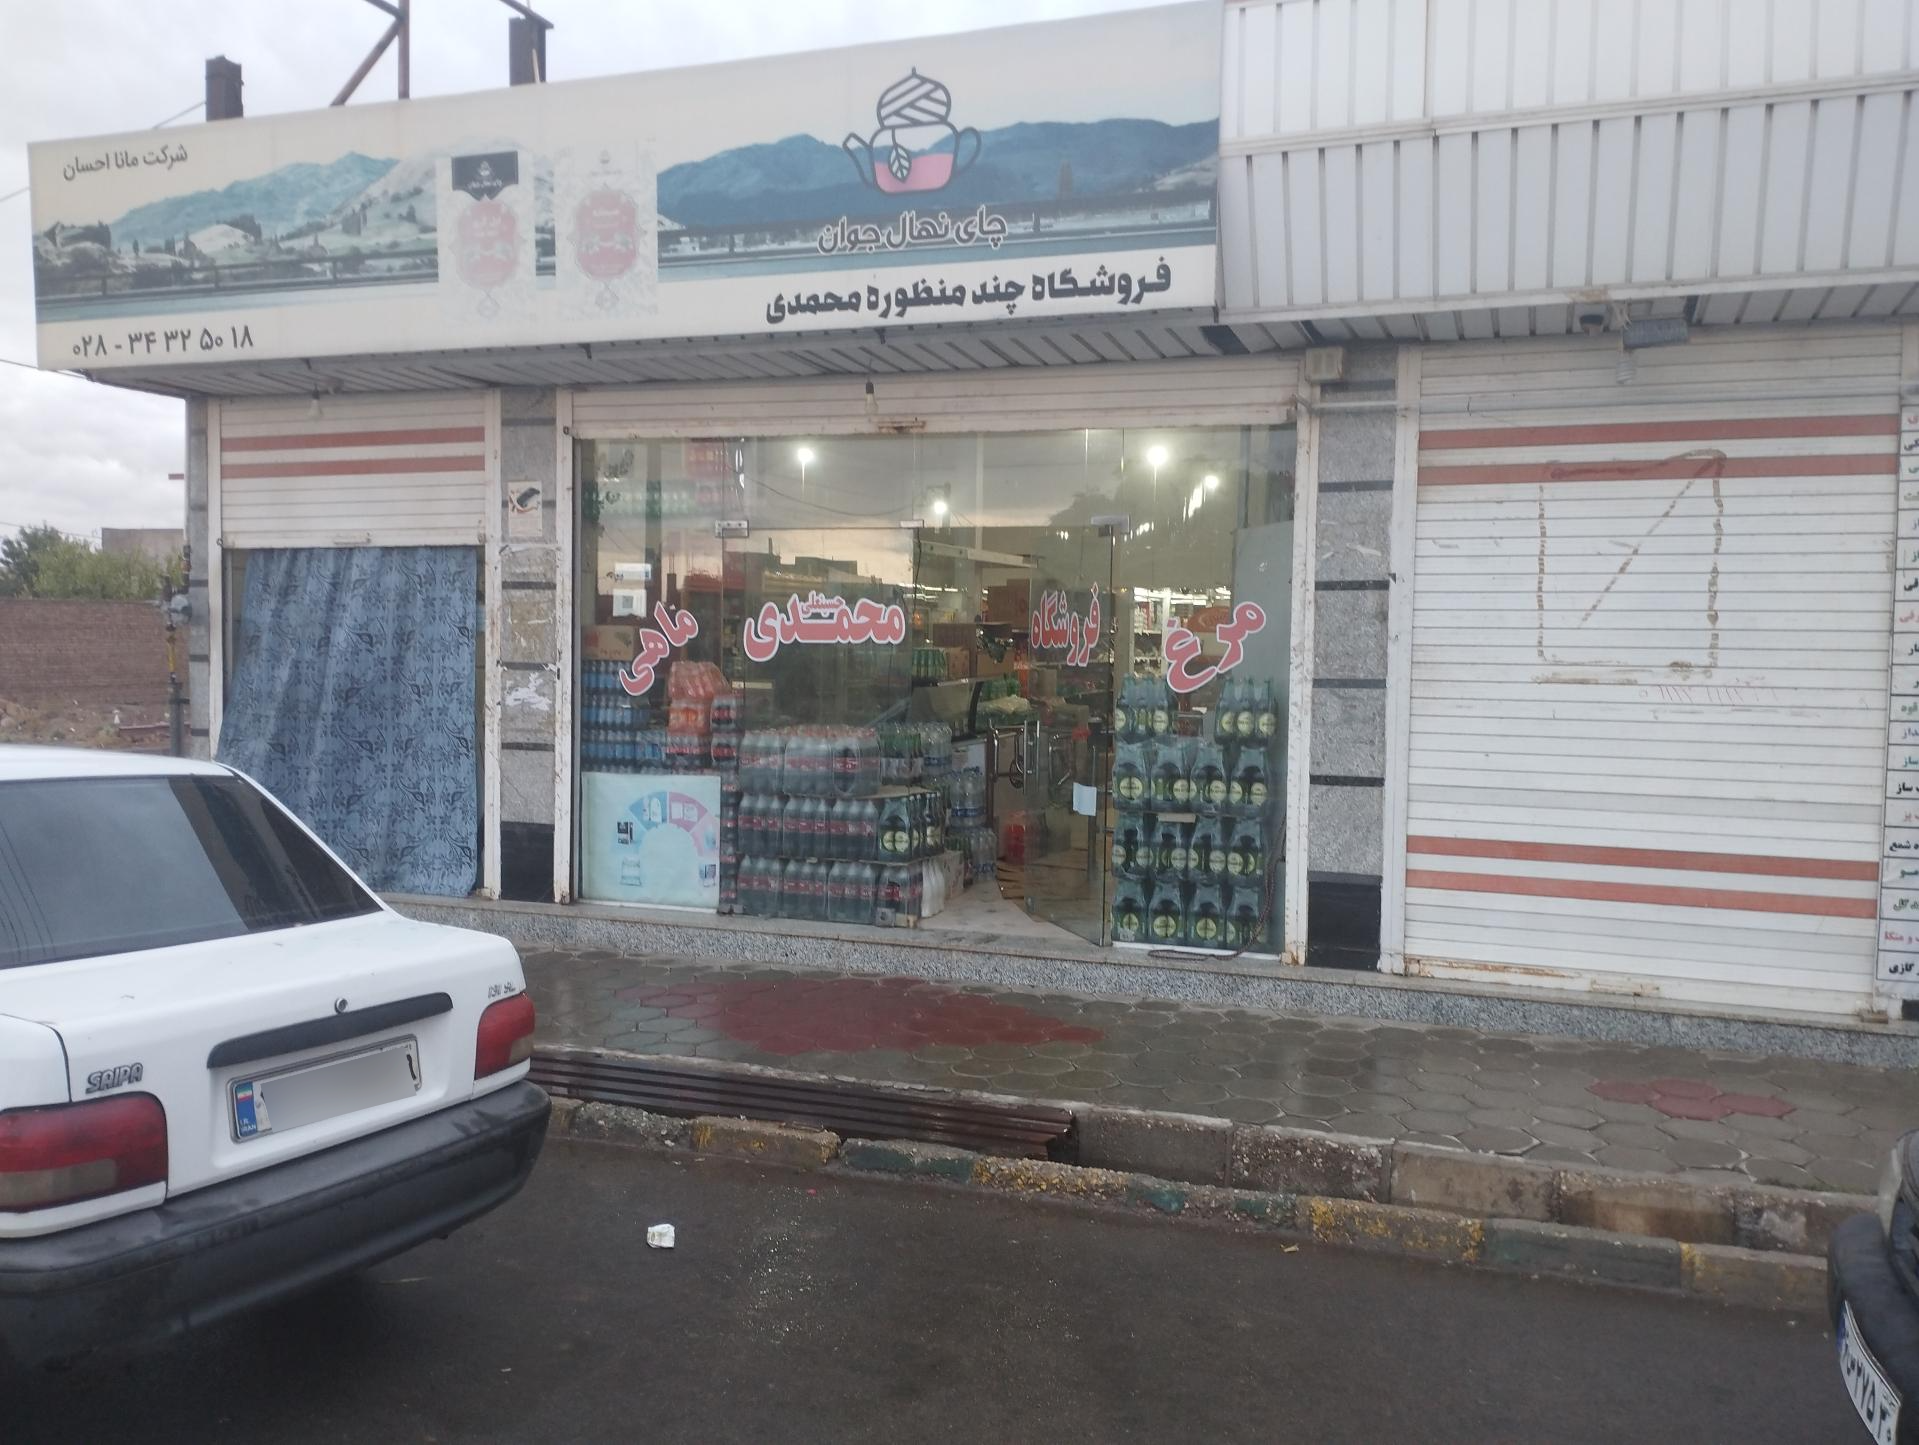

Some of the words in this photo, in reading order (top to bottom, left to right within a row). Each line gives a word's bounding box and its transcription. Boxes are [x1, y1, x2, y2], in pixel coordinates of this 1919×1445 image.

[63, 152, 110, 181] احسان
[114, 150, 139, 169] مانا
[143, 144, 188, 171] شرکت
[817, 215, 882, 256] جوان
[885, 210, 952, 250] نهال
[954, 204, 1009, 250] چای
[867, 278, 967, 318] منظوره
[972, 276, 1026, 315] چند
[1032, 256, 1172, 305] فروشگاه
[766, 286, 862, 325] محمدی
[743, 593, 906, 662] محمدی
[1031, 581, 1100, 667] فروشگاه
[619, 600, 699, 696] ماهی
[1165, 601, 1267, 693] مرغ
[85, 1062, 143, 1095] SAIPA
